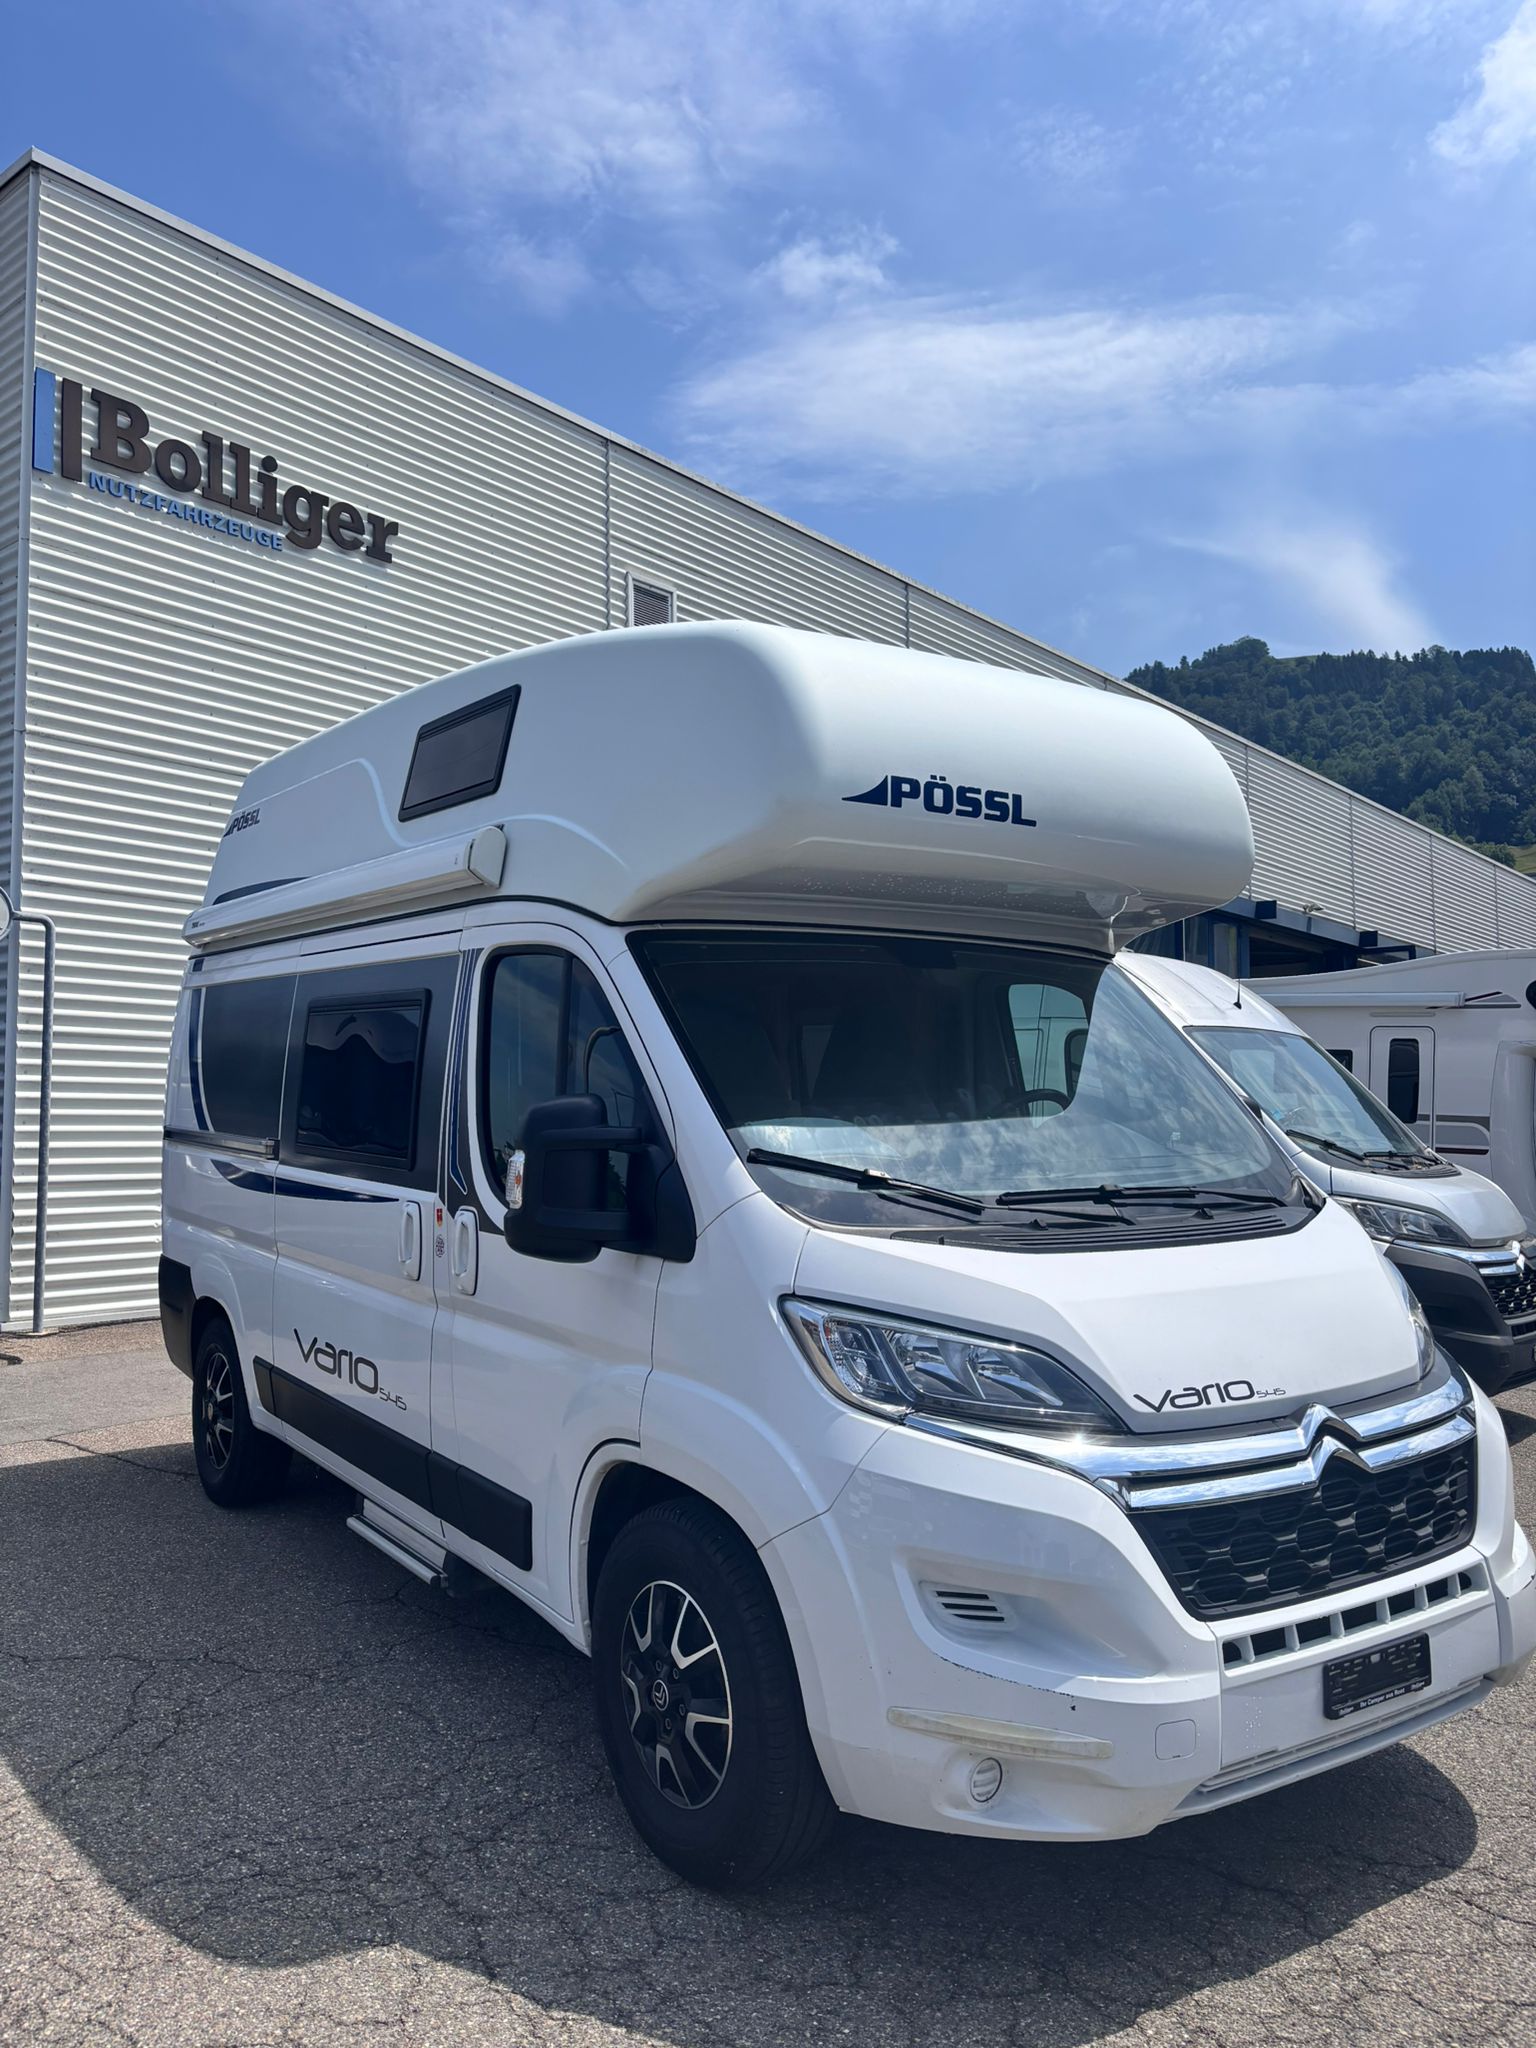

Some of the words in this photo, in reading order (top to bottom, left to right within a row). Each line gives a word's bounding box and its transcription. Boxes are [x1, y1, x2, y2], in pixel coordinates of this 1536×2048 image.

[89, 388, 399, 563] Bolliger
[89, 471, 283, 551] NUTZFAHRZEUGE
[890, 774, 1037, 827] PÖSSL
[230, 807, 261, 835] PÖSSL
[379, 1387, 407, 1411] 545
[1256, 1388, 1286, 1398] 545
